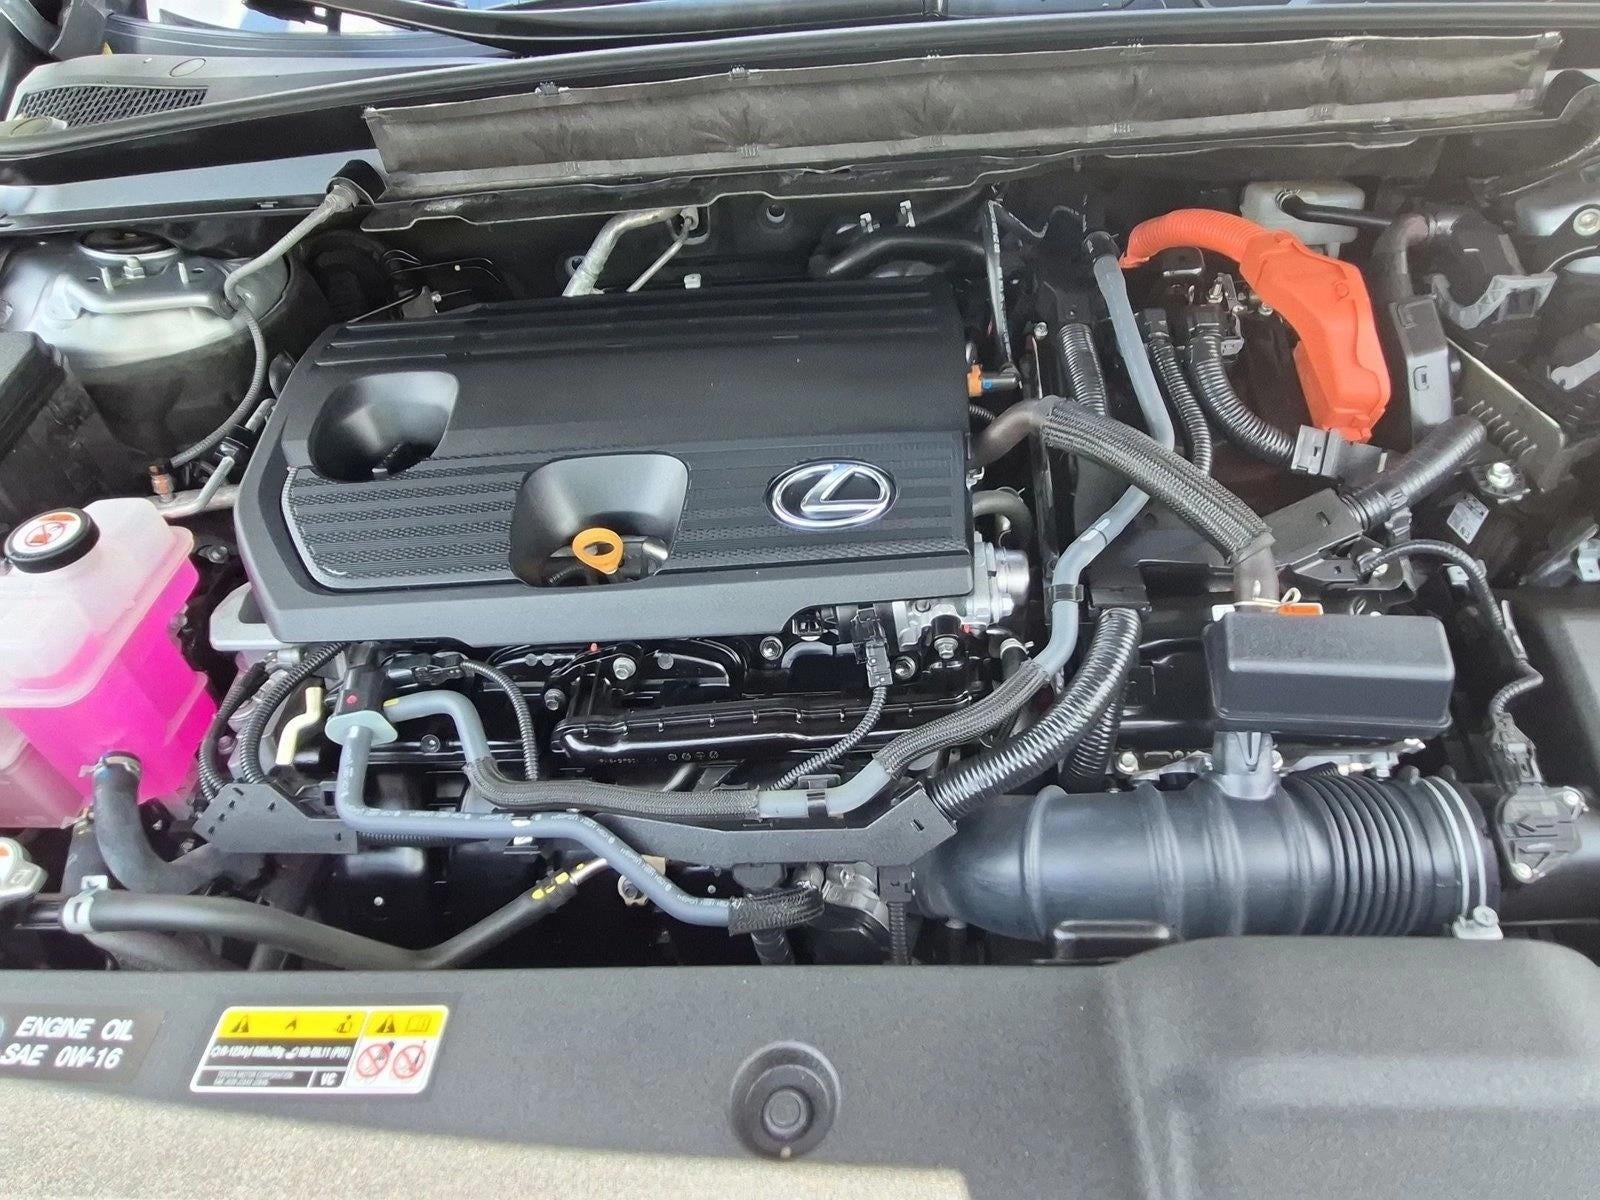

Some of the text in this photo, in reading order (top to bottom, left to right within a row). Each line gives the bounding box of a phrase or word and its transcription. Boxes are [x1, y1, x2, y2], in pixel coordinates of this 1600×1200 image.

[14, 1016, 134, 1041] ENGINE OIL
[0, 1043, 124, 1070] SAE 0W-16
[320, 1071, 338, 1086] VC
